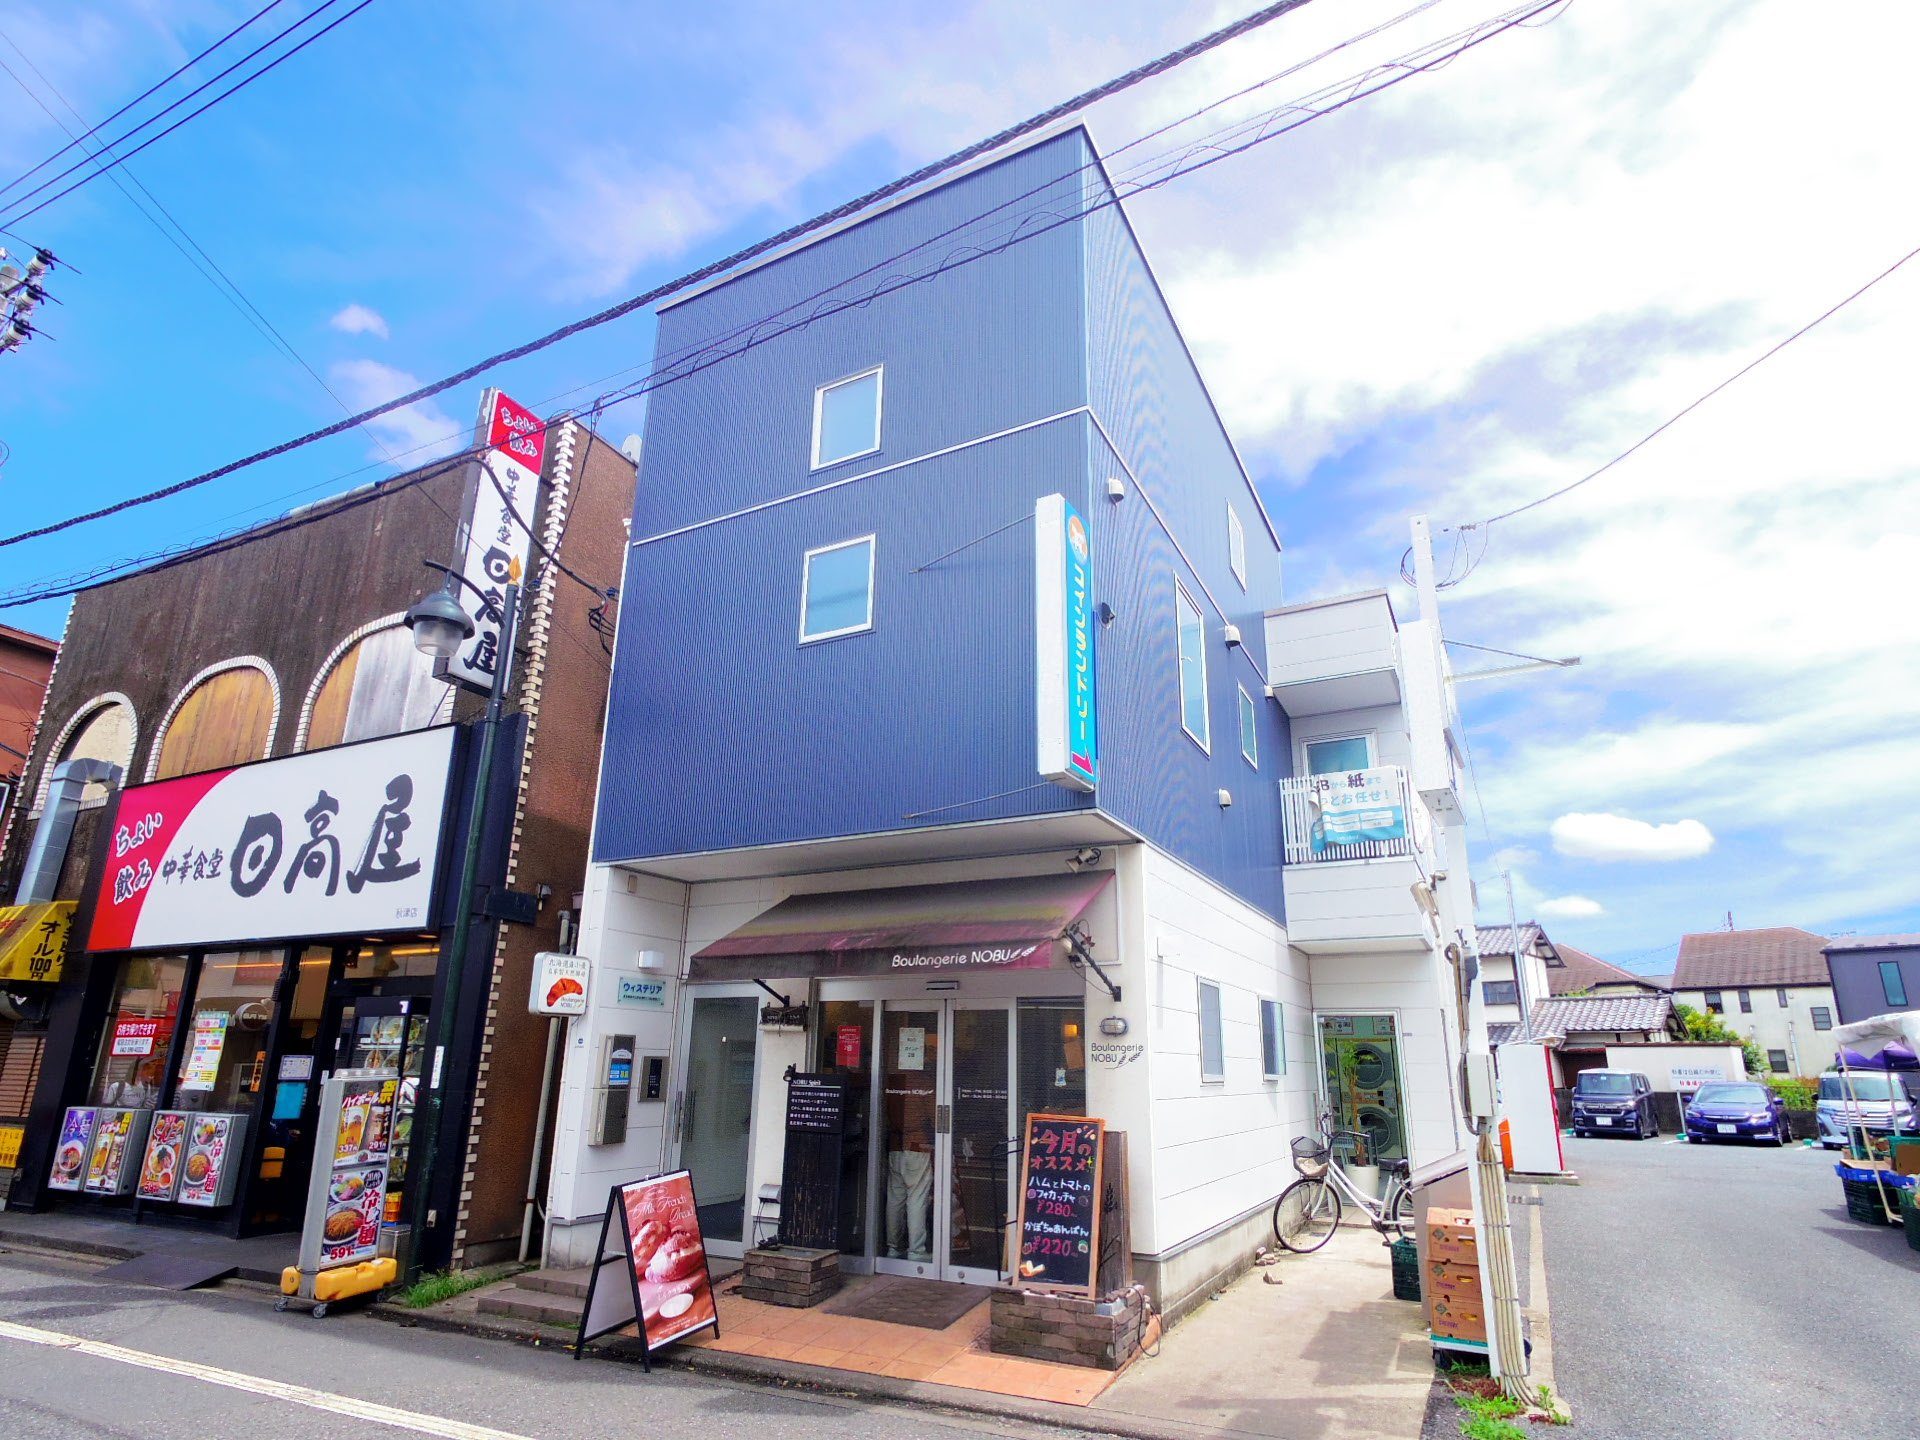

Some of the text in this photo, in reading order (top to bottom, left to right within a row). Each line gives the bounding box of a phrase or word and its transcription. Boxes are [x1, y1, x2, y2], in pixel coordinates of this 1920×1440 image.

[508, 431, 539, 457] 飲み
[1074, 563, 1088, 741] コインランドリー
[115, 811, 163, 858] ちょい
[230, 773, 421, 898] 日高屋
[161, 845, 224, 885] 中華食堂
[113, 858, 153, 905] 飲み
[34, 920, 61, 956] オール
[29, 957, 53, 973] 100
[892, 949, 1012, 968] Boulangerie NOBU
[623, 982, 663, 995] ウィステリア
[1091, 1042, 1144, 1054] Boulangerie
[1091, 1053, 1117, 1063] NOBU
[341, 1091, 379, 1108] ハイボール
[1039, 1128, 1092, 1157] 今月の
[1030, 1155, 1088, 1172] オススメ
[1028, 1175, 1091, 1192] ハムとトマトの
[1036, 1188, 1076, 1204] フォカッチャ
[358, 1190, 380, 1245] 冷し麺
[1024, 1220, 1090, 1237] かぼちゃあんぱん
